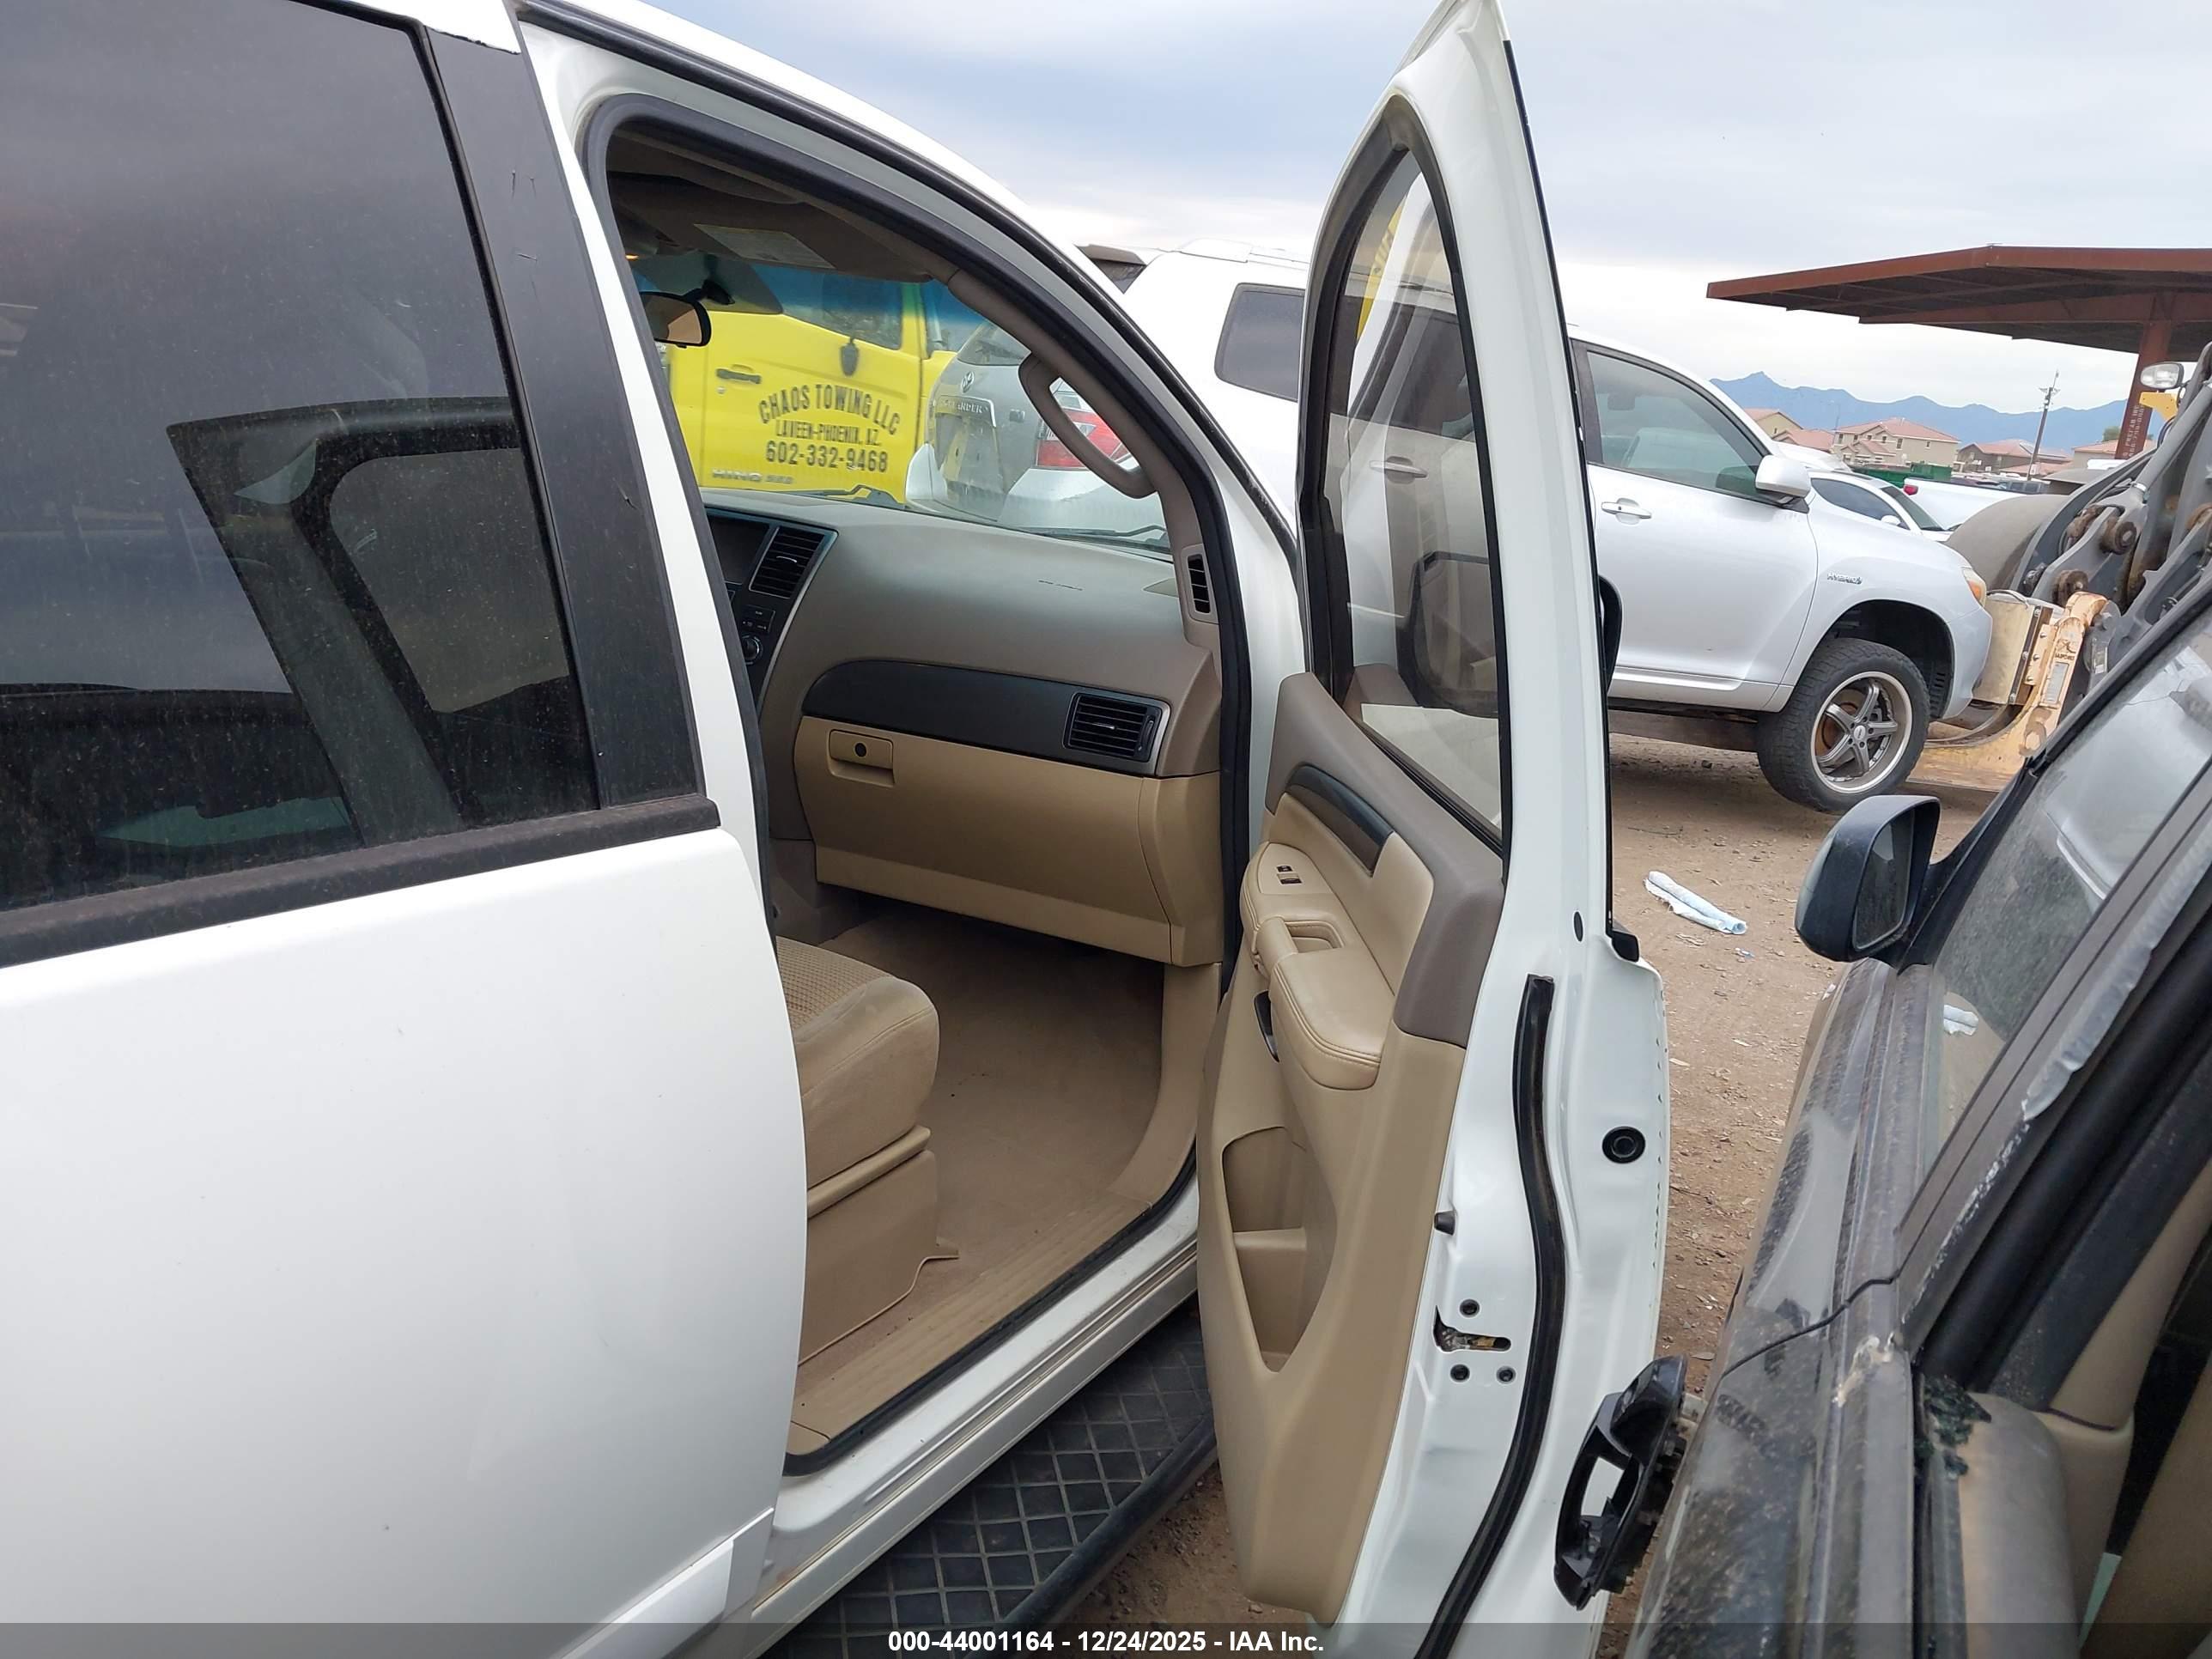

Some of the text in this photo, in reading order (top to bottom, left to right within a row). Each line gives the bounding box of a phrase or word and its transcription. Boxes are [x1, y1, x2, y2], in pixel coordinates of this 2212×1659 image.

[759, 384, 900, 435] CHAOS TOWING LLC
[766, 441, 889, 473] 602-332-9468
